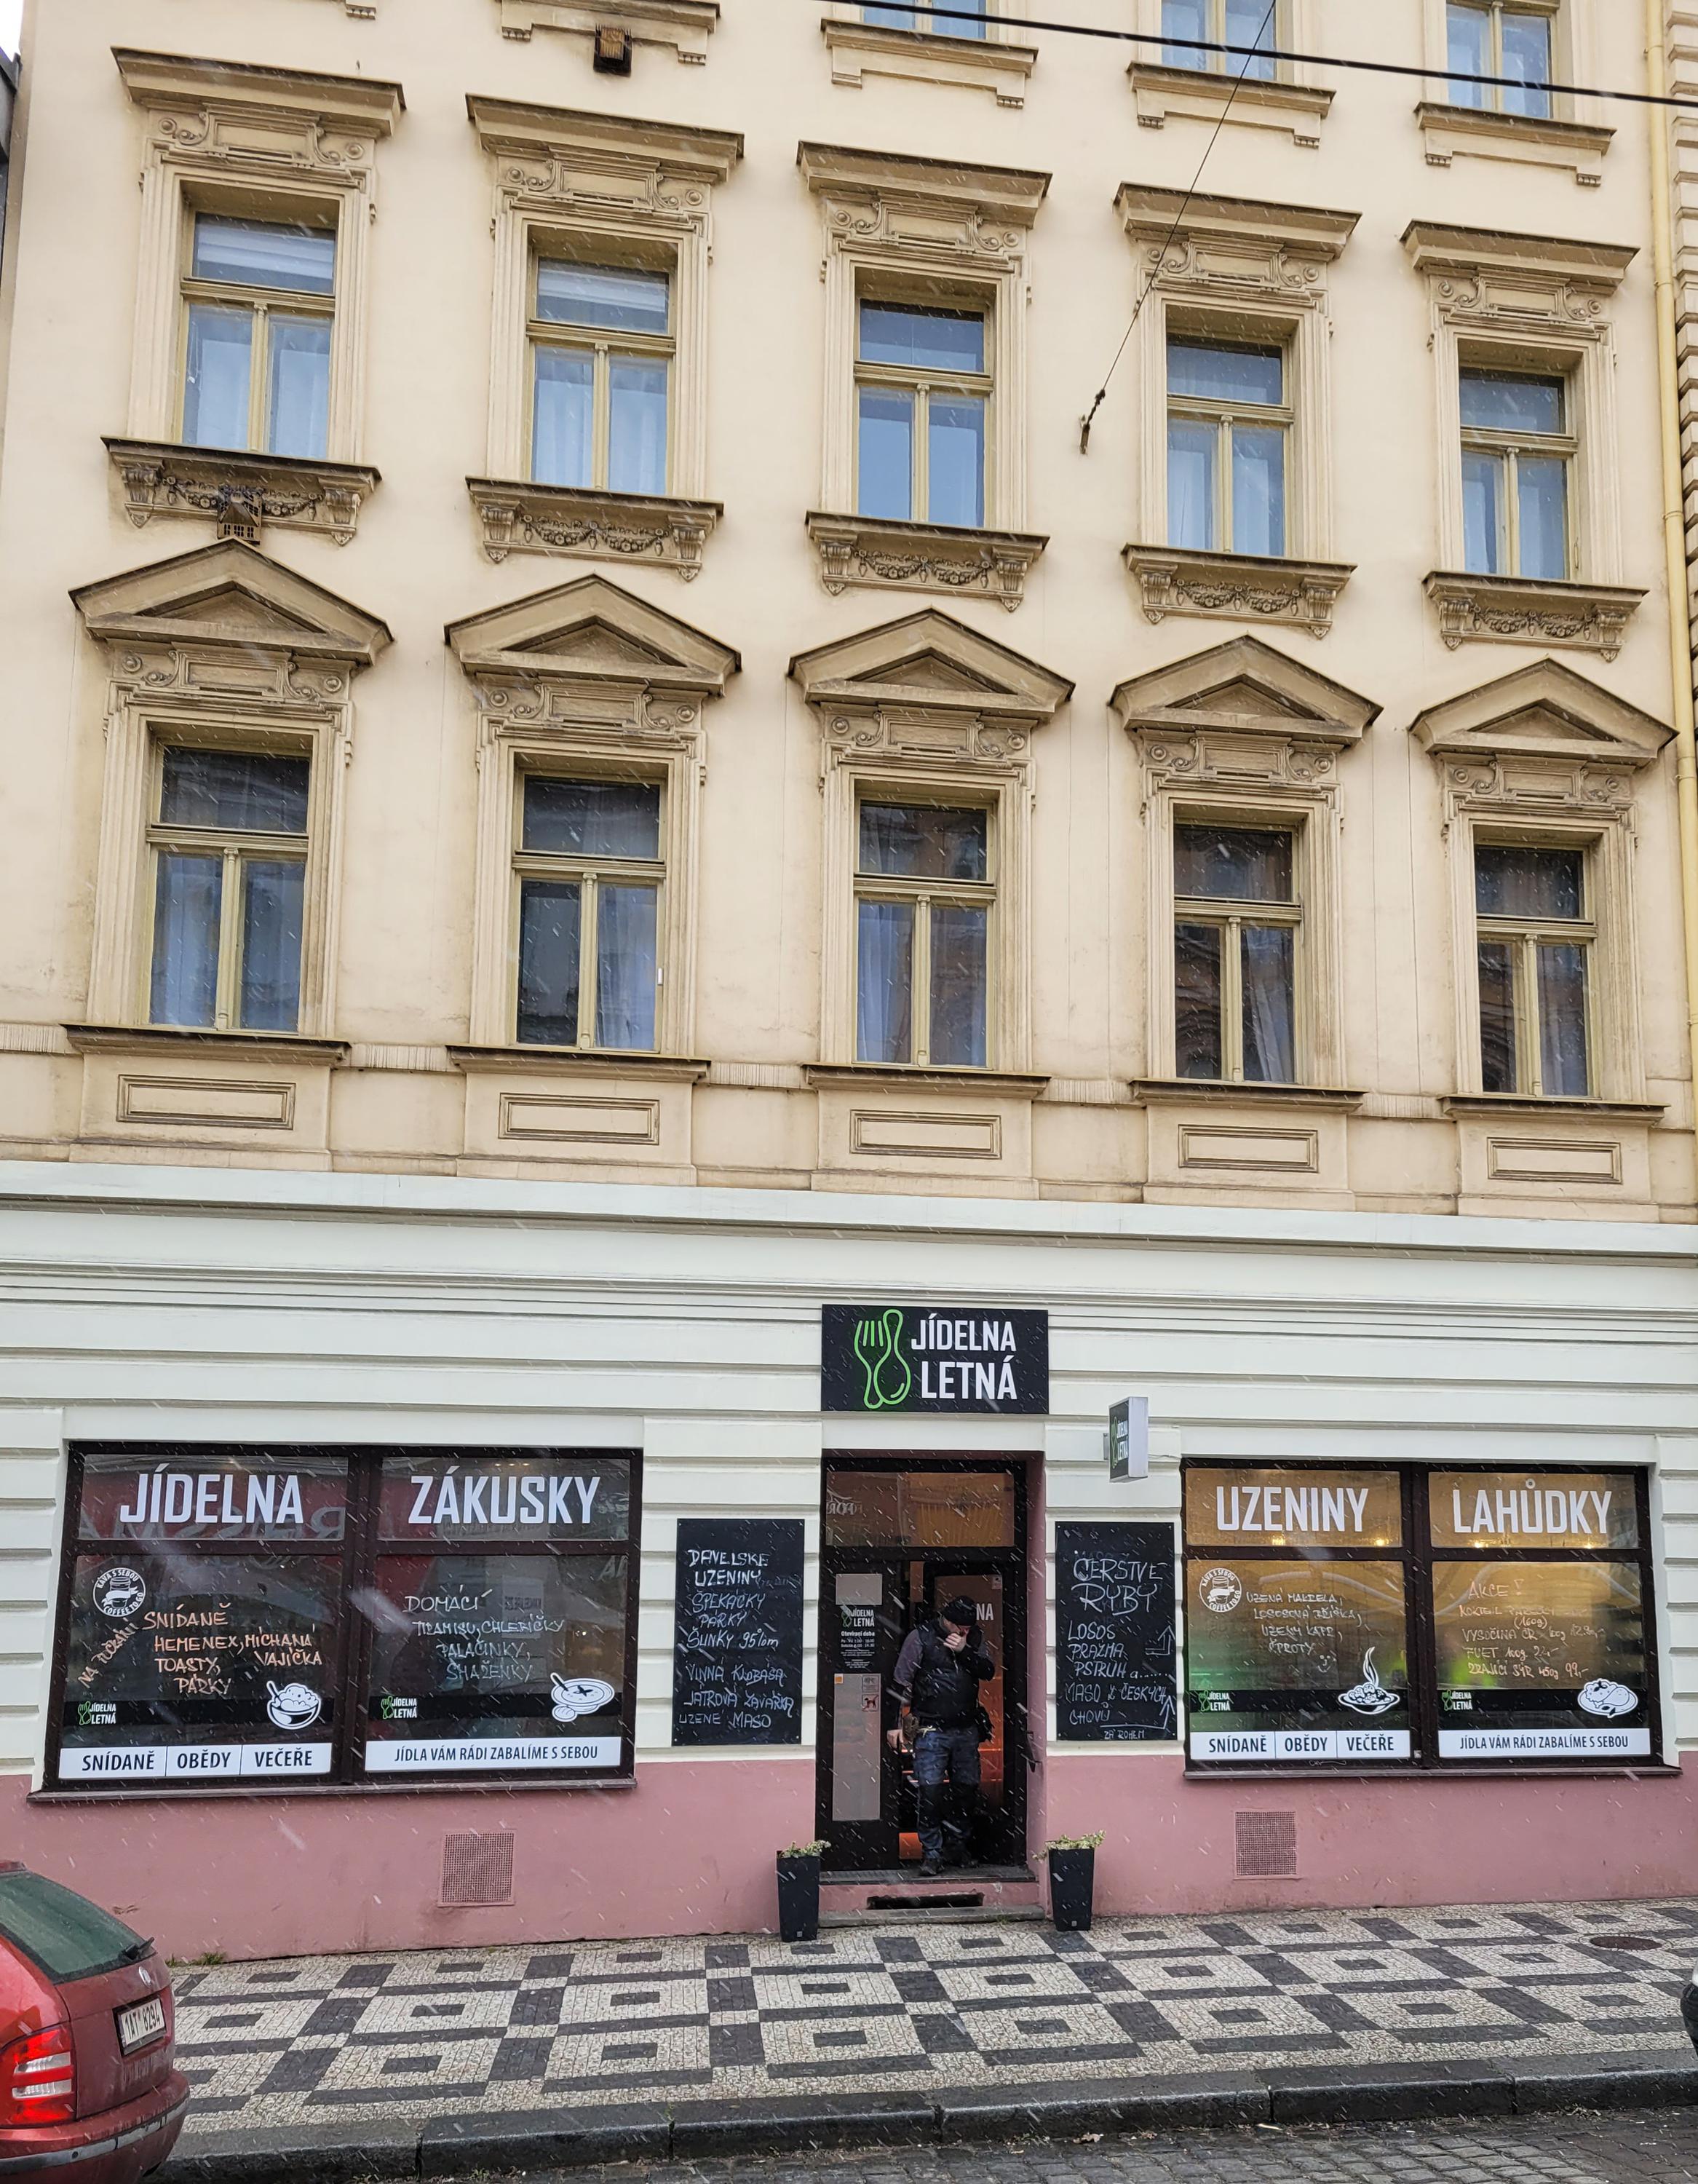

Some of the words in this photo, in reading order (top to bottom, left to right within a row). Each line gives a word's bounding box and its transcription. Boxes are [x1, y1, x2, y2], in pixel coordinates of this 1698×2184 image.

[911, 1313, 1016, 1351] JÍDELNA
[921, 1356, 1017, 1400] LETNÁ
[119, 1463, 304, 1524] JÍDELNA
[408, 1465, 600, 1524] ZÁKUSKY
[1216, 1487, 1368, 1532] UZENINY
[1452, 1479, 1612, 1535] LAHŮDKY
[118, 1570, 139, 1582] SEBOU
[694, 1570, 761, 1588] UZENINY
[1467, 1580, 1509, 1599] AKCE
[103, 1606, 130, 1615] COFFEE
[129, 1602, 138, 1610] TO
[135, 1592, 143, 1602] GO
[1071, 1583, 1158, 1616] RYBY
[141, 1602, 231, 1631] SNÍDANĚ
[851, 1608, 874, 1618] JÍDELNA
[854, 1616, 875, 1627] LETNÁ
[686, 1626, 734, 1649] ŠUNKY
[1068, 1620, 1116, 1641] LOSOS
[392, 1697, 417, 1707] JÍDELNA
[1207, 1691, 1230, 1701] JÍDELNA
[1450, 1690, 1472, 1700] JÍDELNA
[90, 1702, 116, 1712] JÍDELNA
[394, 1706, 417, 1718] LETNÁ
[1210, 1700, 1231, 1711] LETNÁ
[1453, 1700, 1473, 1710] LETNÁ
[91, 1712, 116, 1725] LETNÁ
[730, 1711, 771, 1729] MASO
[1208, 1733, 1268, 1753] SNÍDANĚ
[1284, 1733, 1328, 1752] OBĚDY
[1346, 1734, 1394, 1752] VEČEŘE
[1460, 1735, 1487, 1749] JÍDLA
[1488, 1735, 1510, 1749] VÁM
[1513, 1734, 1536, 1749] RÁDI
[1538, 1734, 1587, 1748] ZABALÍME
[1590, 1736, 1595, 1748] S
[1597, 1736, 1629, 1748] SEBOU
[82, 1749, 155, 1771] SNÍDANĚ
[177, 1749, 231, 1769] OBĚDY
[254, 1746, 313, 1768] VEČEŘE
[394, 1745, 427, 1762] JÍDLA
[431, 1744, 456, 1761] VÁM
[459, 1744, 488, 1760] RÁDI
[490, 1744, 548, 1760] ZABALÍME
[551, 1746, 558, 1760] S
[560, 1745, 598, 1760] SEBOU
